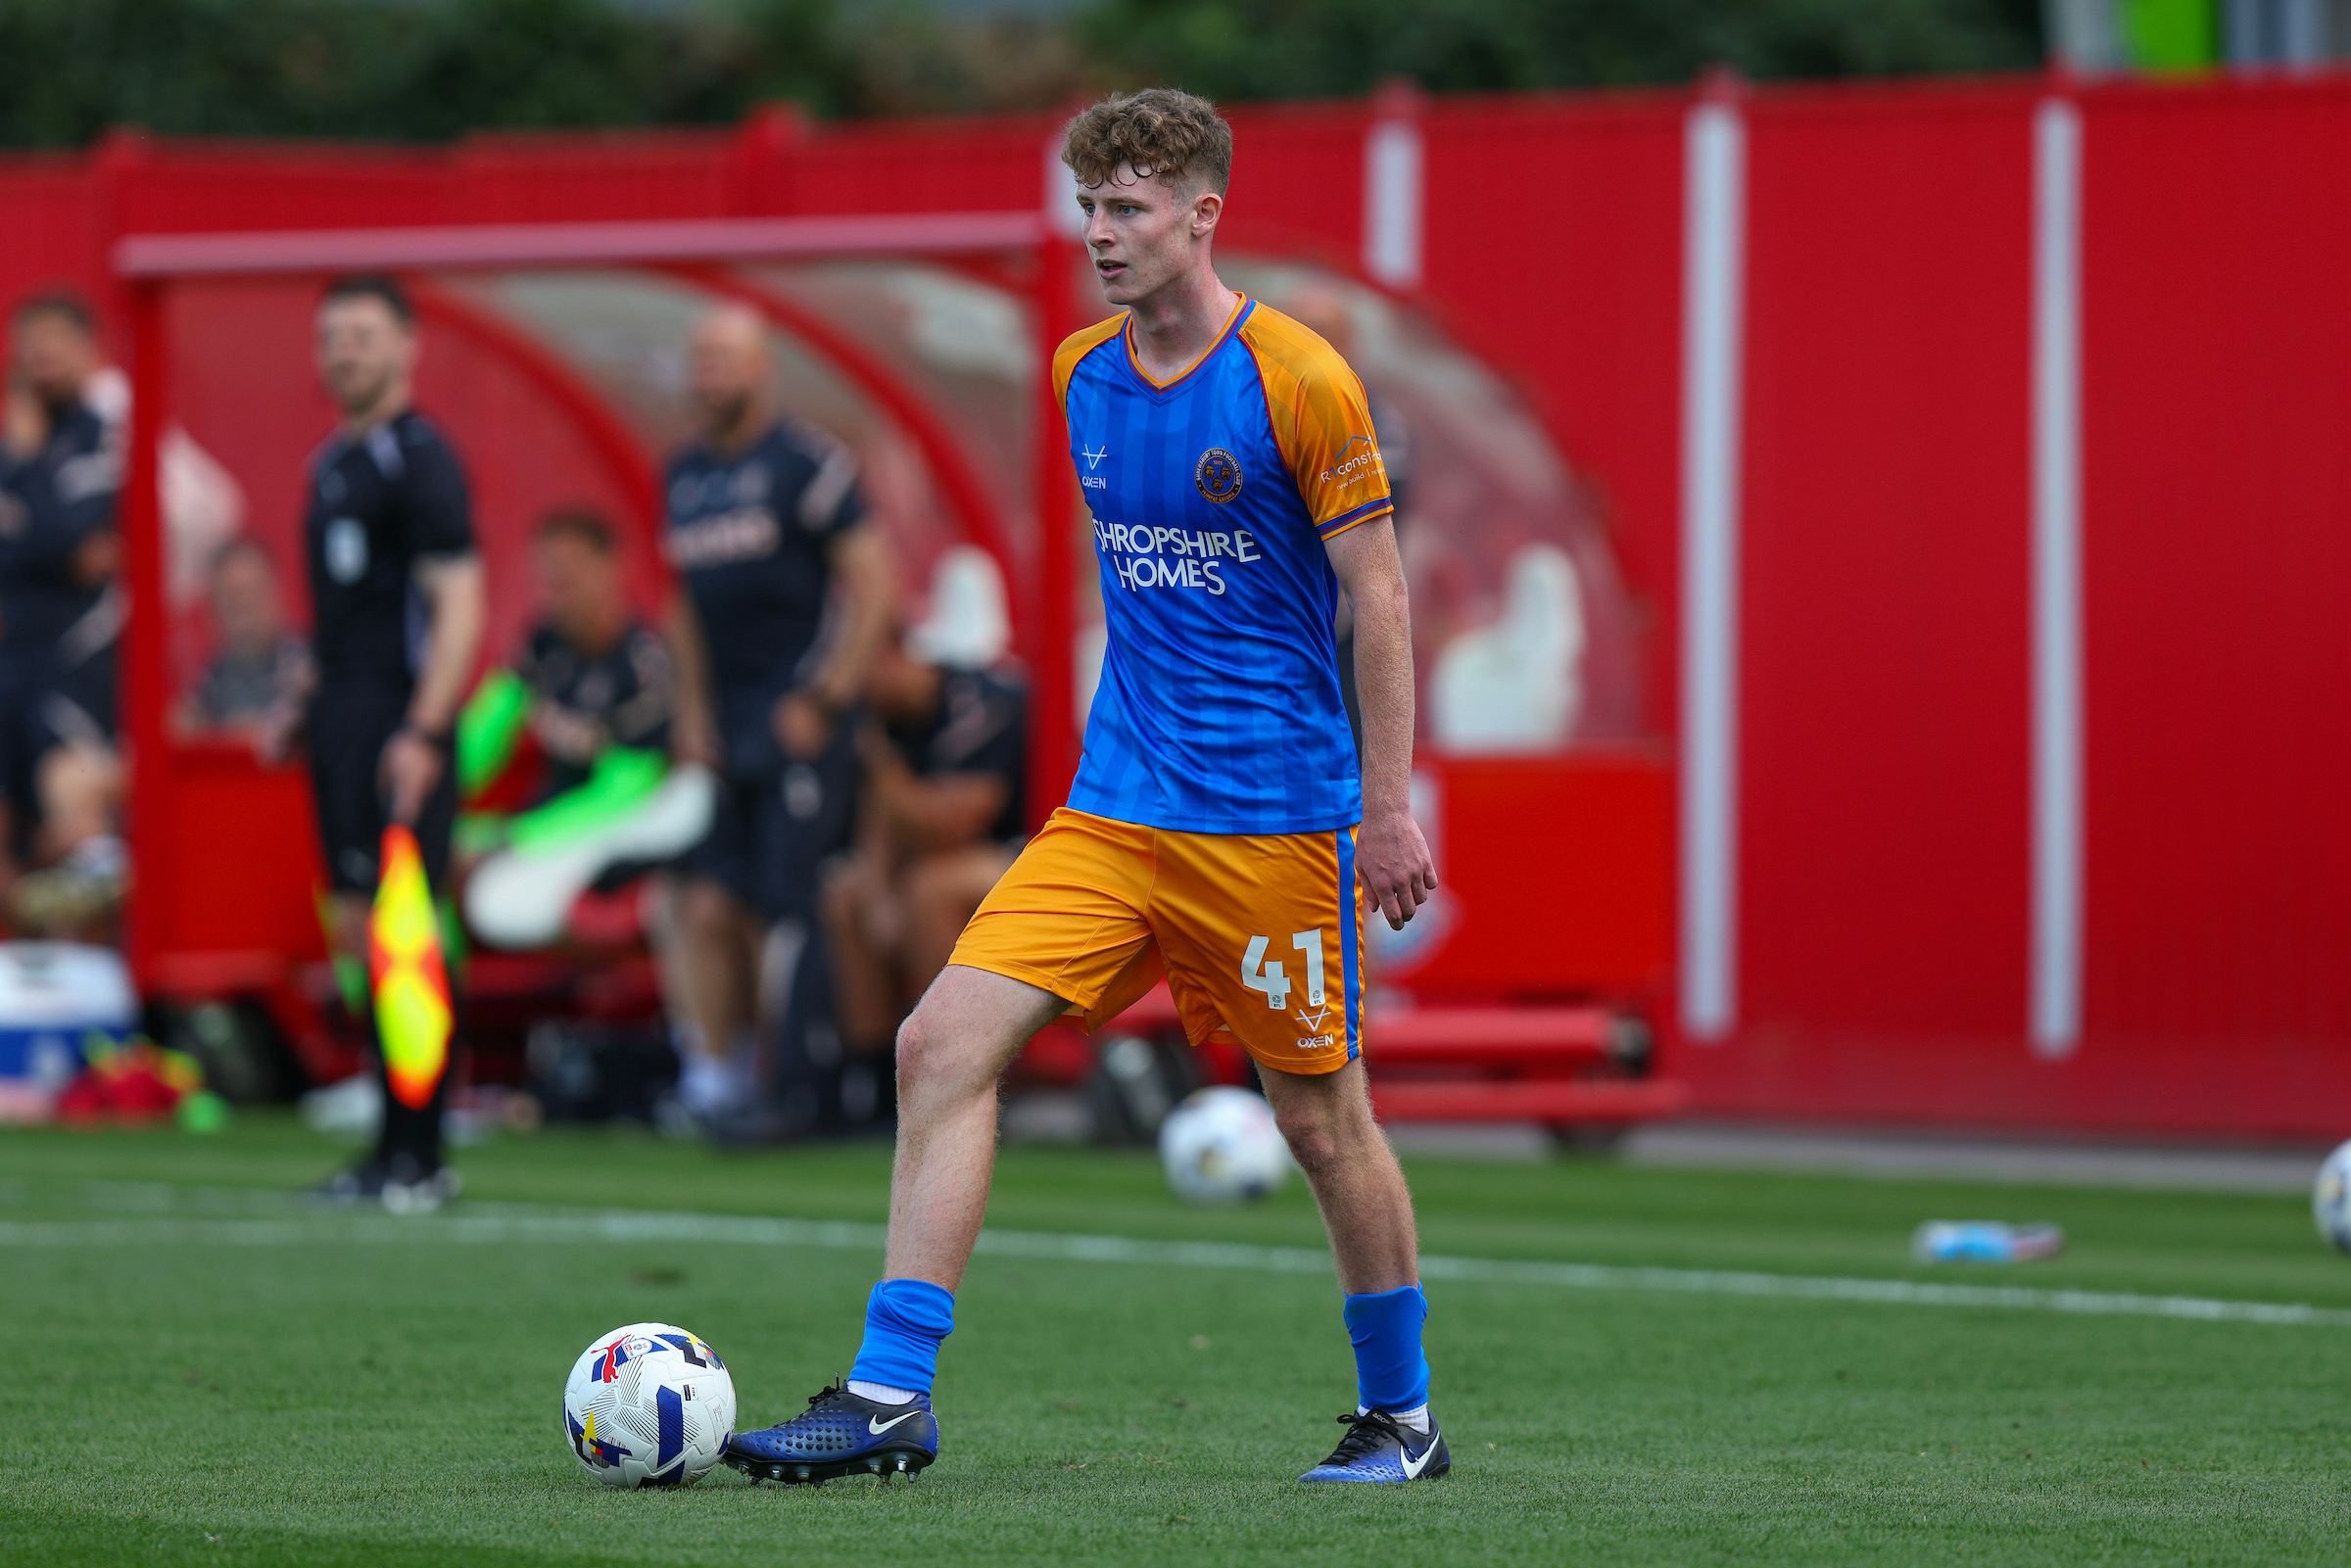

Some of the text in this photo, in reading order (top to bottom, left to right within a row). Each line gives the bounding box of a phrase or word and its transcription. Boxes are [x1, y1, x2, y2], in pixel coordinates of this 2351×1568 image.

[1081, 475, 1107, 490] OXEN
[1092, 518, 1262, 563] SHROPSHIRE
[1114, 554, 1226, 595] HOMES
[1241, 927, 1326, 1010] 41
[1296, 1033, 1334, 1049] OXEN
